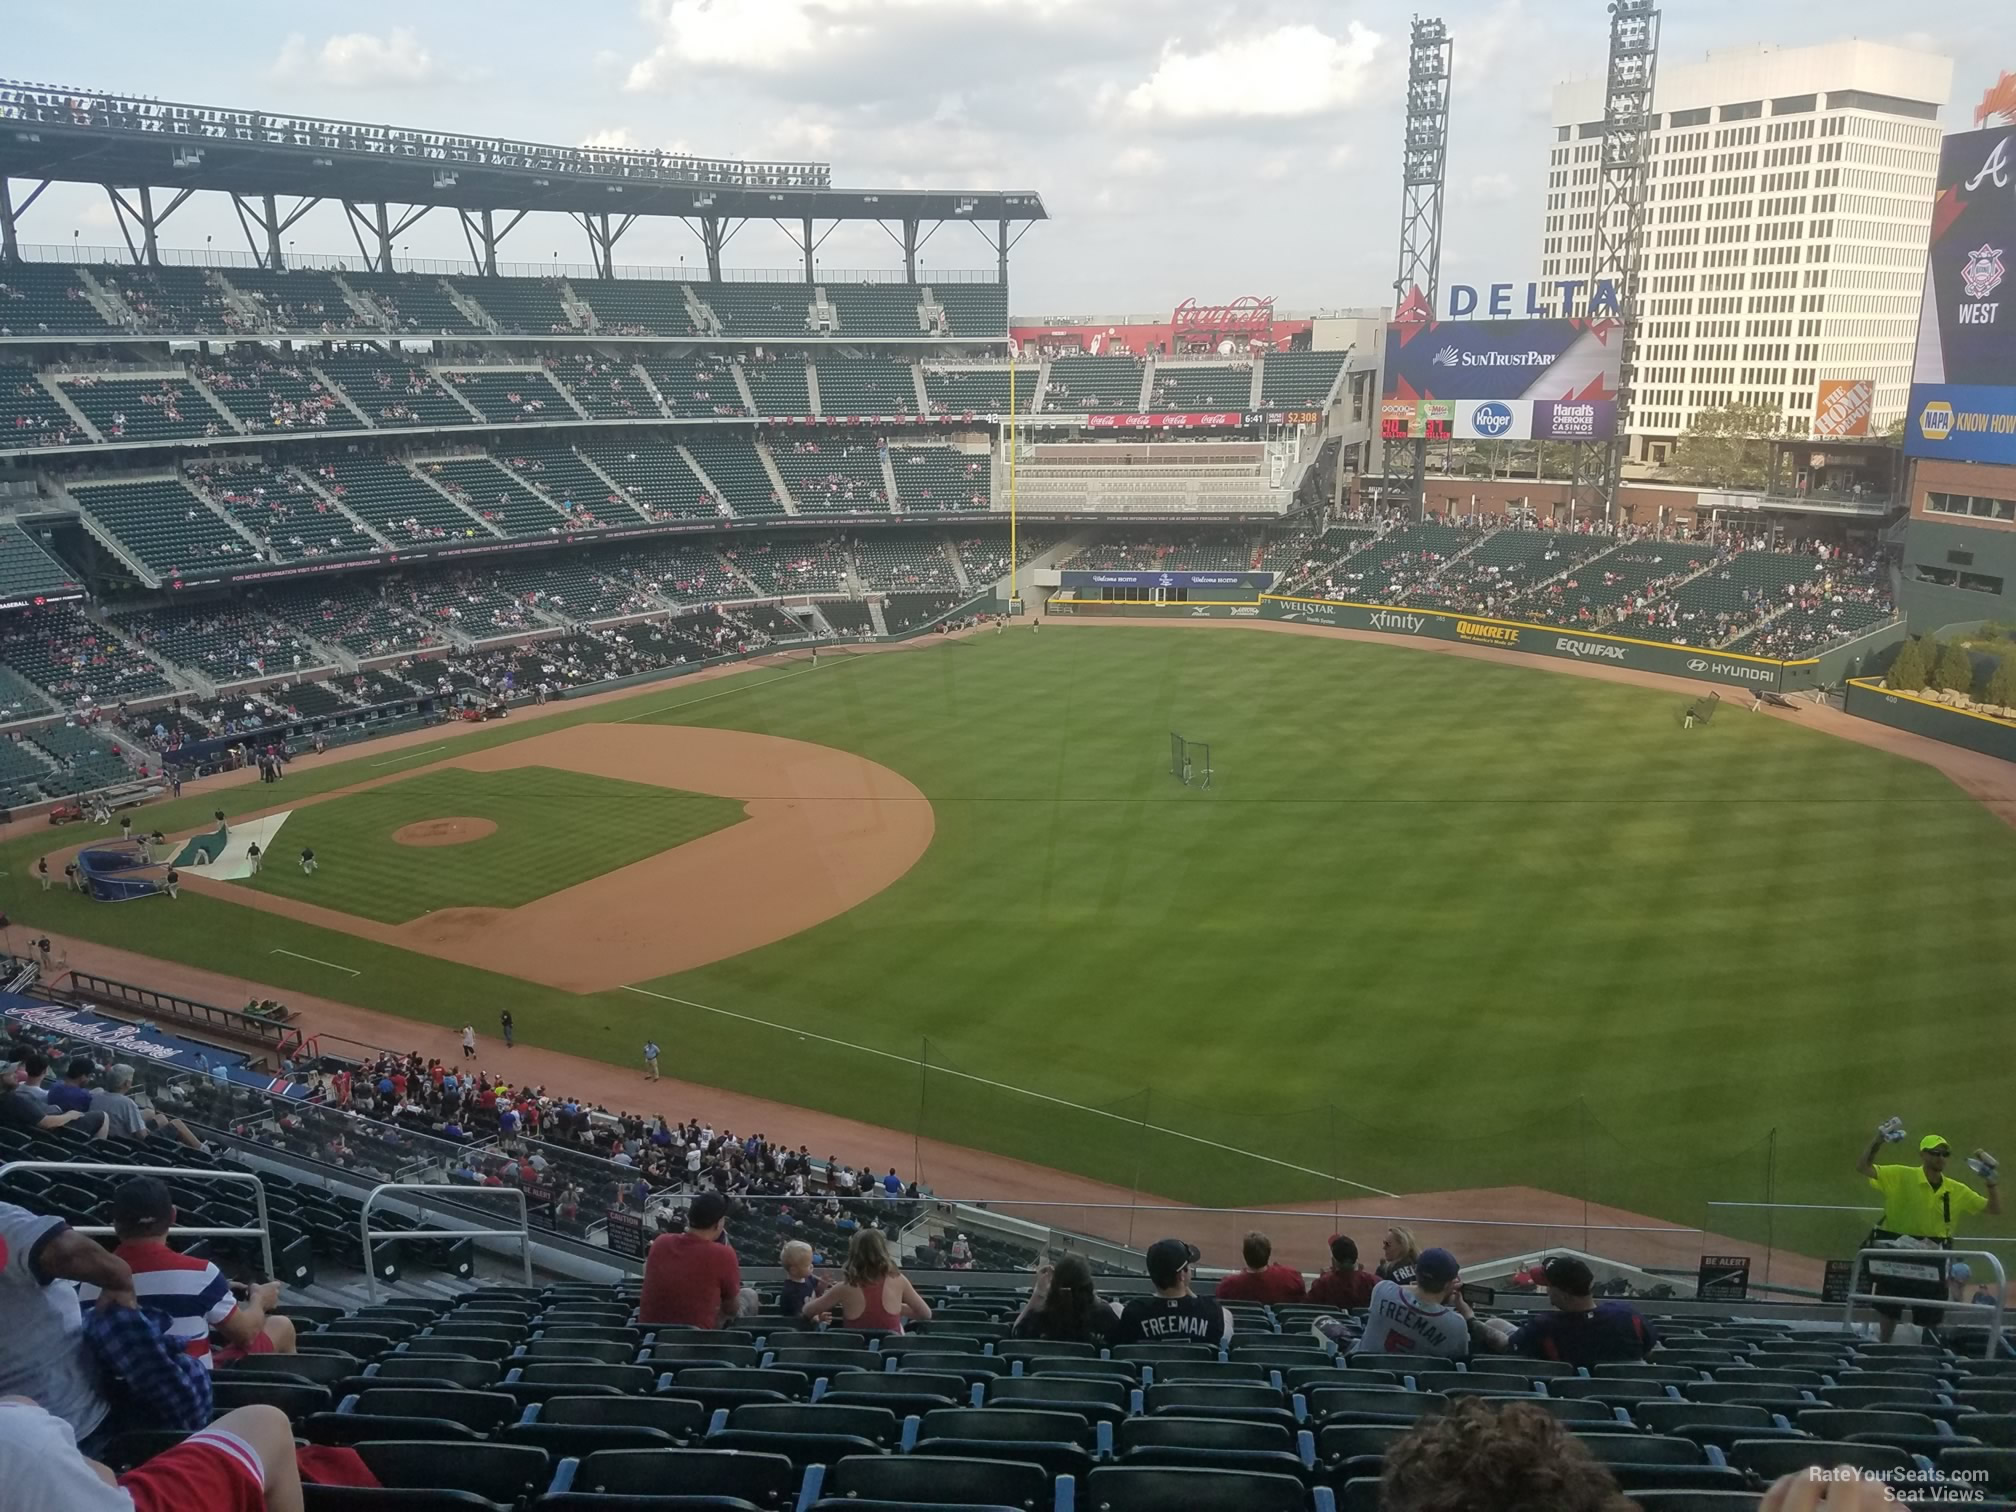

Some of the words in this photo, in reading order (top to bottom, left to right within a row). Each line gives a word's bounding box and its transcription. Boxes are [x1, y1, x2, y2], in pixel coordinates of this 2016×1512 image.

[1449, 278, 1619, 316] DELTA
[1959, 303, 1999, 324] WEST
[1822, 385, 1847, 408] THE
[1553, 403, 1594, 416] Harrah's
[1814, 380, 1872, 434] HOME
[985, 413, 999, 424] 42
[1245, 414, 1263, 423] 6:41
[1288, 412, 1317, 424] $2,308
[1476, 407, 1511, 433] Kroger
[1552, 416, 1594, 424] CHEROKEE
[1834, 400, 1871, 435] DEPOT
[1925, 411, 1949, 430] NAPA
[1956, 412, 1989, 433] KNOW
[1990, 414, 2016, 434] HOW
[262, 569, 296, 578] INFORMATION
[1280, 601, 1336, 615] WELLSTAR
[1369, 611, 1425, 633] xfinity
[1456, 620, 1520, 641] QUIKRETE
[1556, 637, 1627, 659] EQUIFAX
[1711, 663, 1774, 682] HYUNDAI
[1886, 695, 1898, 704] 400
[610, 1211, 639, 1226] CAUTION
[1705, 1257, 1718, 1265] BE
[1720, 1258, 1746, 1266] ALERT
[1141, 1315, 1209, 1338] FREEMAN
[1380, 1299, 1447, 1347] FREEMAN
